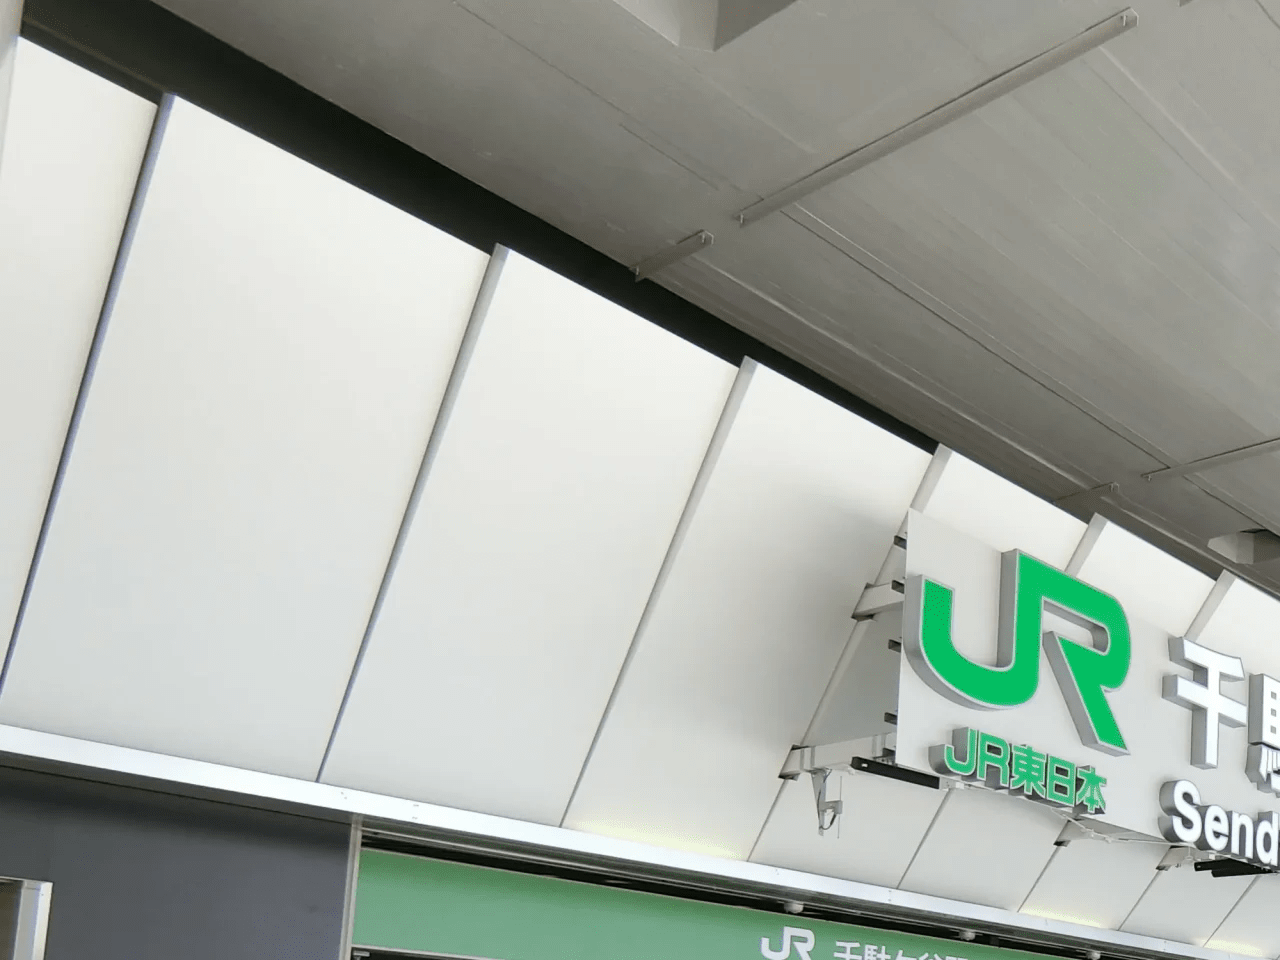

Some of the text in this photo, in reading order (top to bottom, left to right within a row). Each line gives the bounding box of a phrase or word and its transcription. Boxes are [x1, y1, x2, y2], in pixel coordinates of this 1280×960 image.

[906, 548, 1131, 756] JR
[938, 726, 1108, 814] JR東日本
